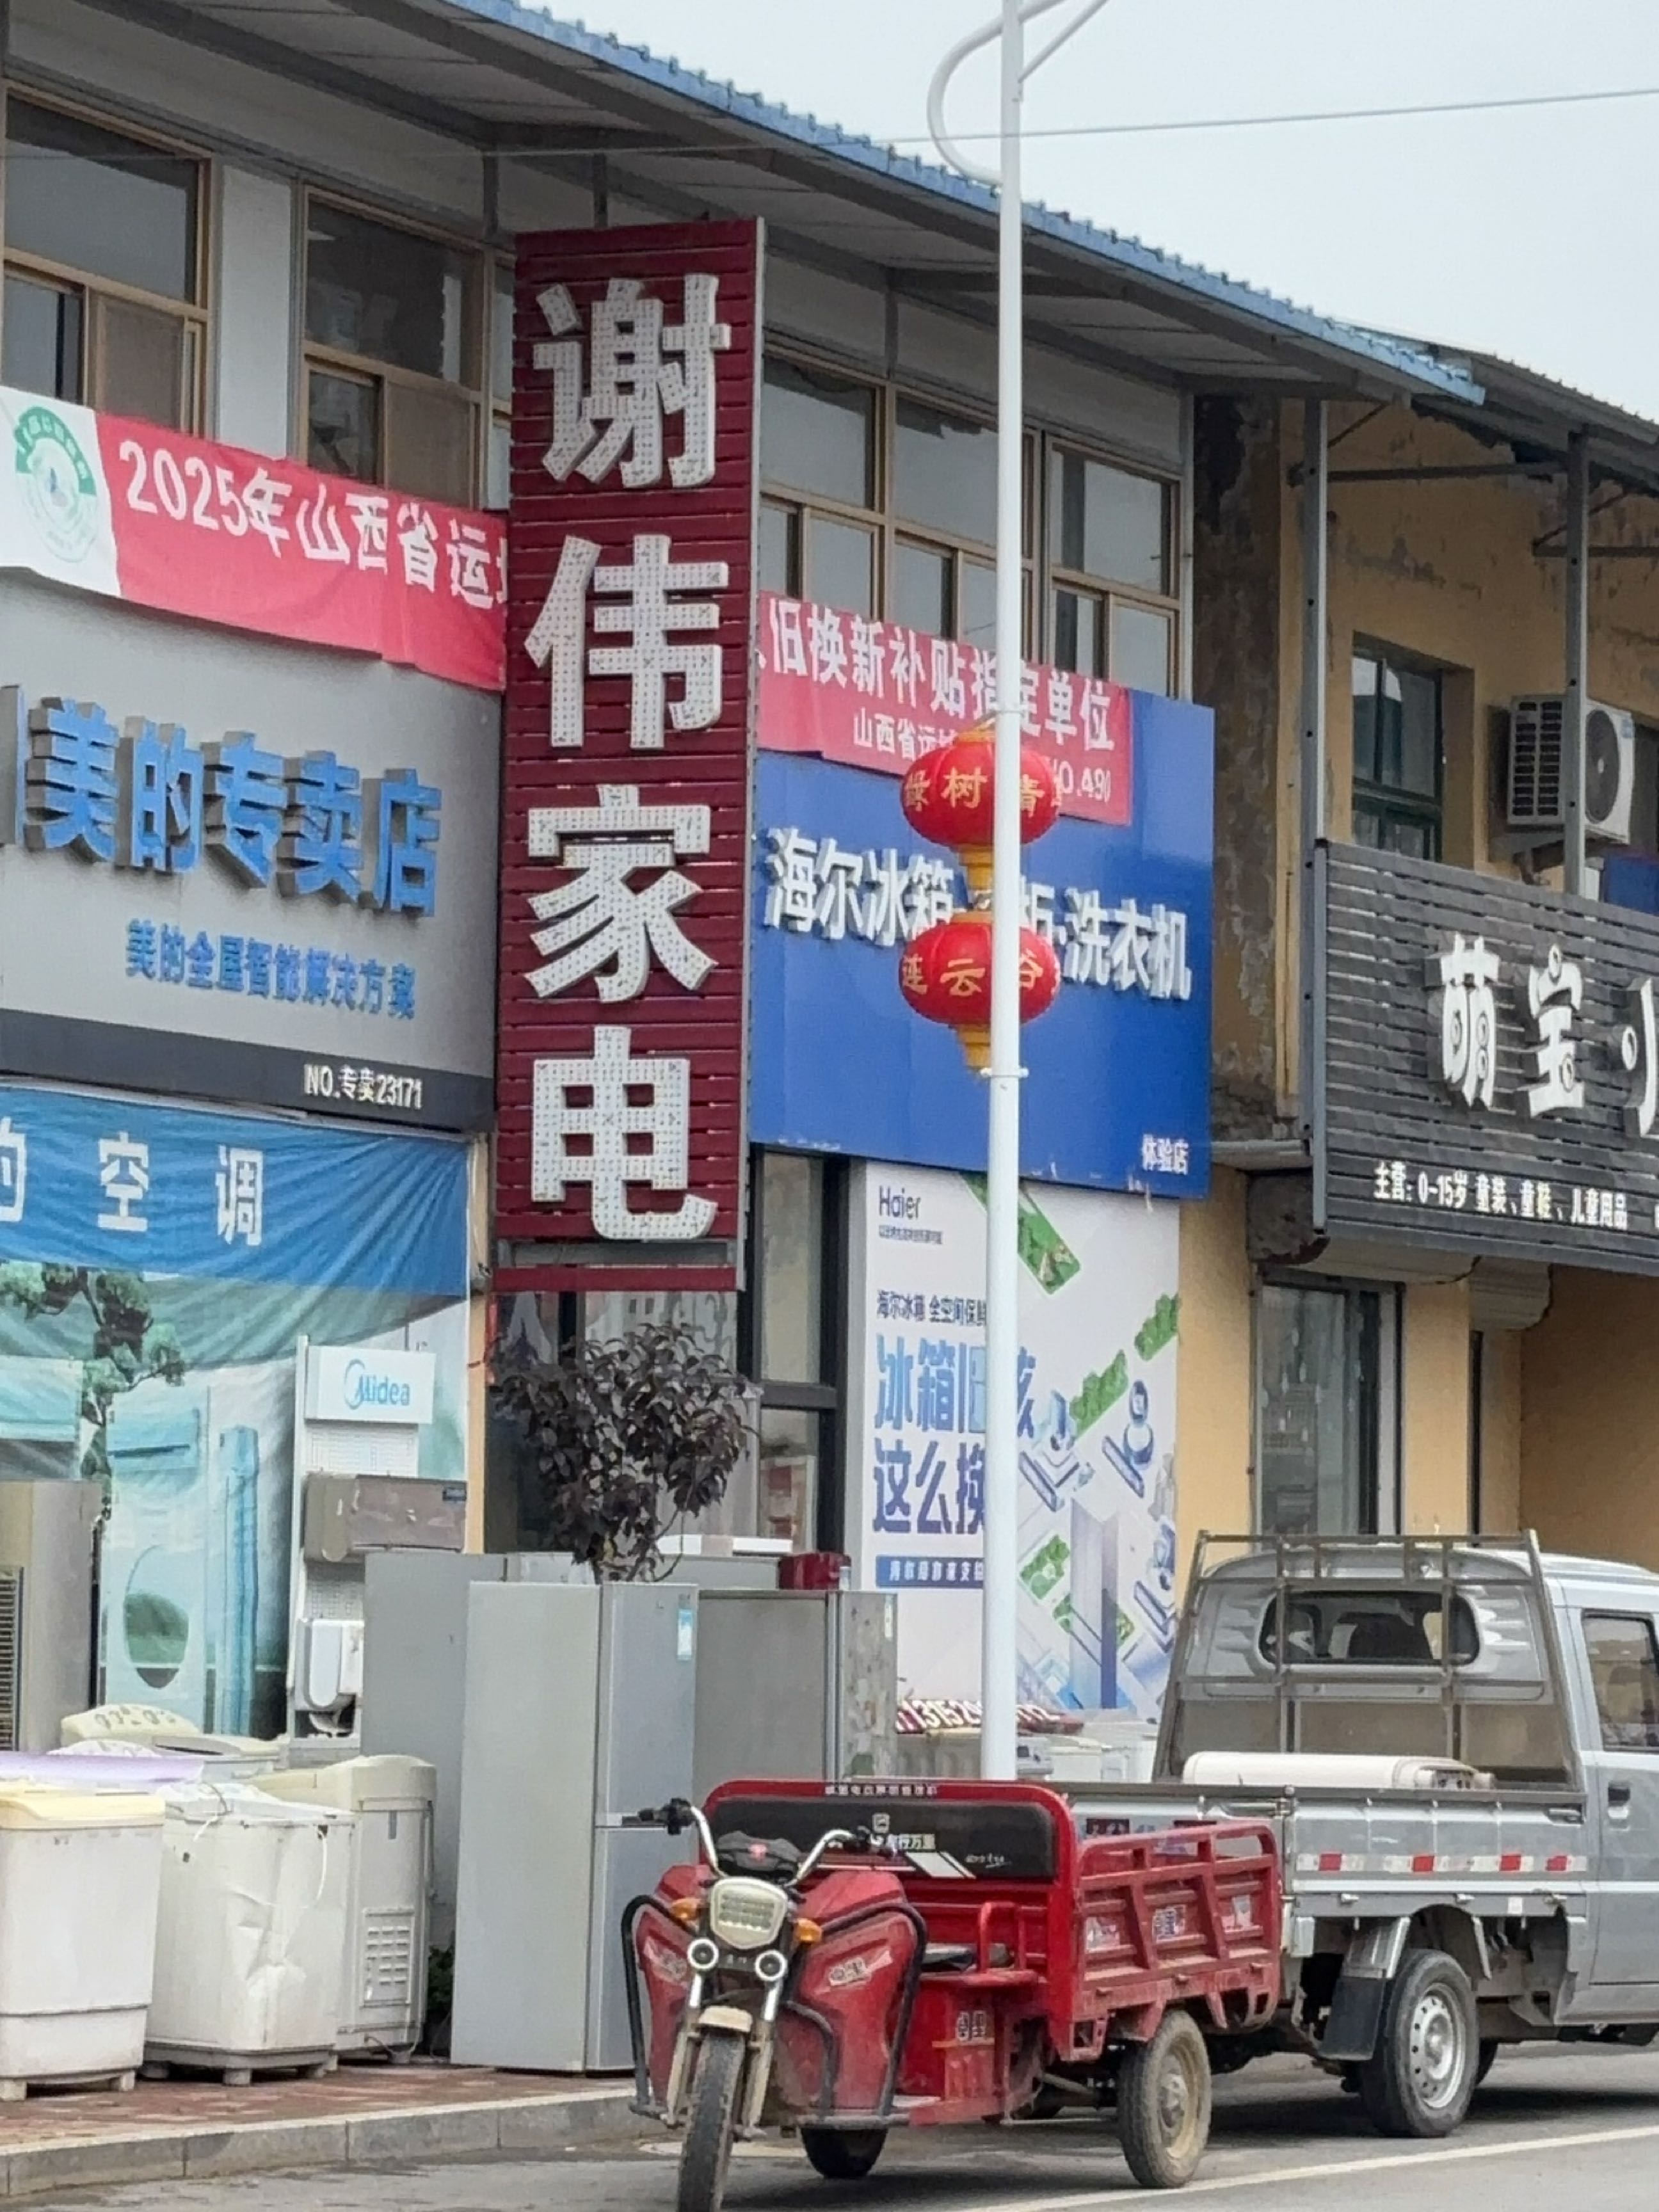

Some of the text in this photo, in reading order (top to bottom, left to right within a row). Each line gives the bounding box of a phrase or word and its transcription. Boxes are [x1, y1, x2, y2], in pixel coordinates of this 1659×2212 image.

[119, 440, 508, 609] 2025年山西省运
[755, 598, 1115, 752] 旧换新补贴指定单位
[28, 698, 442, 917] 美的专卖店
[522, 272, 731, 1242] 谢伟家电
[125, 918, 415, 1020] 美的全屋智能解决方案
[303, 1062, 422, 1110] NO.专卖23171
[879, 1185, 921, 1220] Haier
[348, 1366, 411, 1409] Midea
